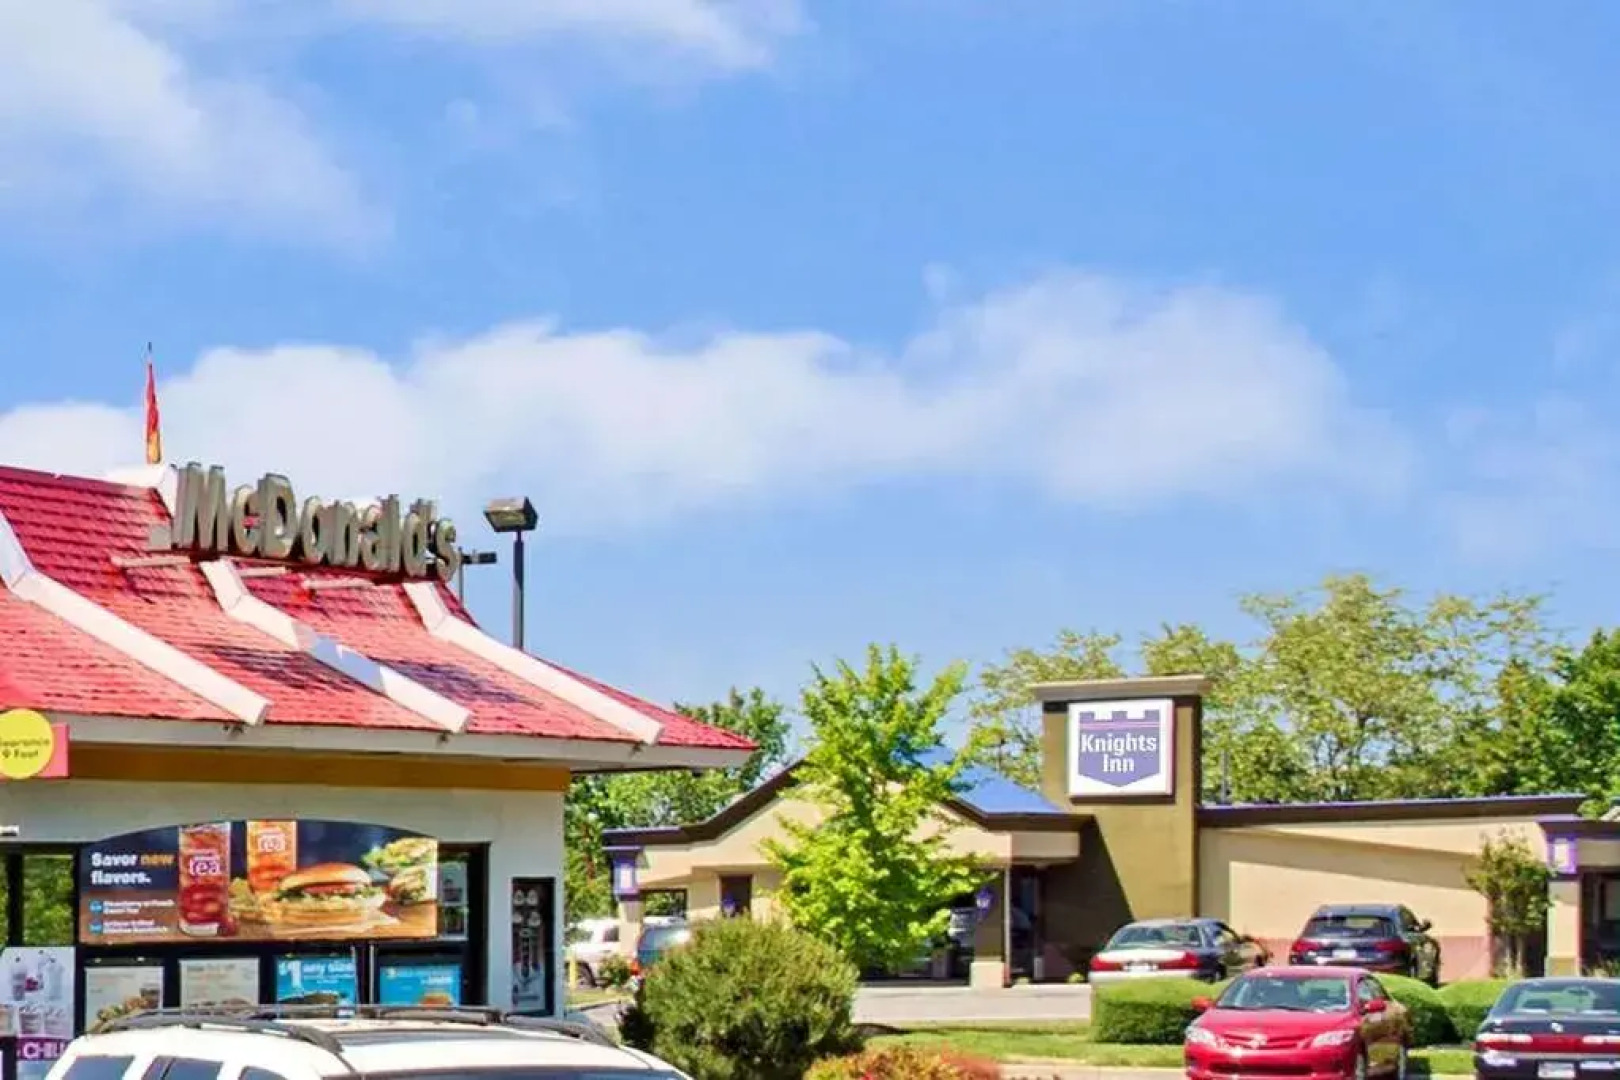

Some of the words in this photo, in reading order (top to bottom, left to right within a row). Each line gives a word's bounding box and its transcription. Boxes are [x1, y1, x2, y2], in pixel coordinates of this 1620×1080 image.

[171, 461, 460, 582] McDonald's
[1081, 732, 1157, 756] Knights
[1103, 753, 1135, 773] Inn
[91, 852, 138, 867] Savor
[91, 870, 152, 885] flavors.
